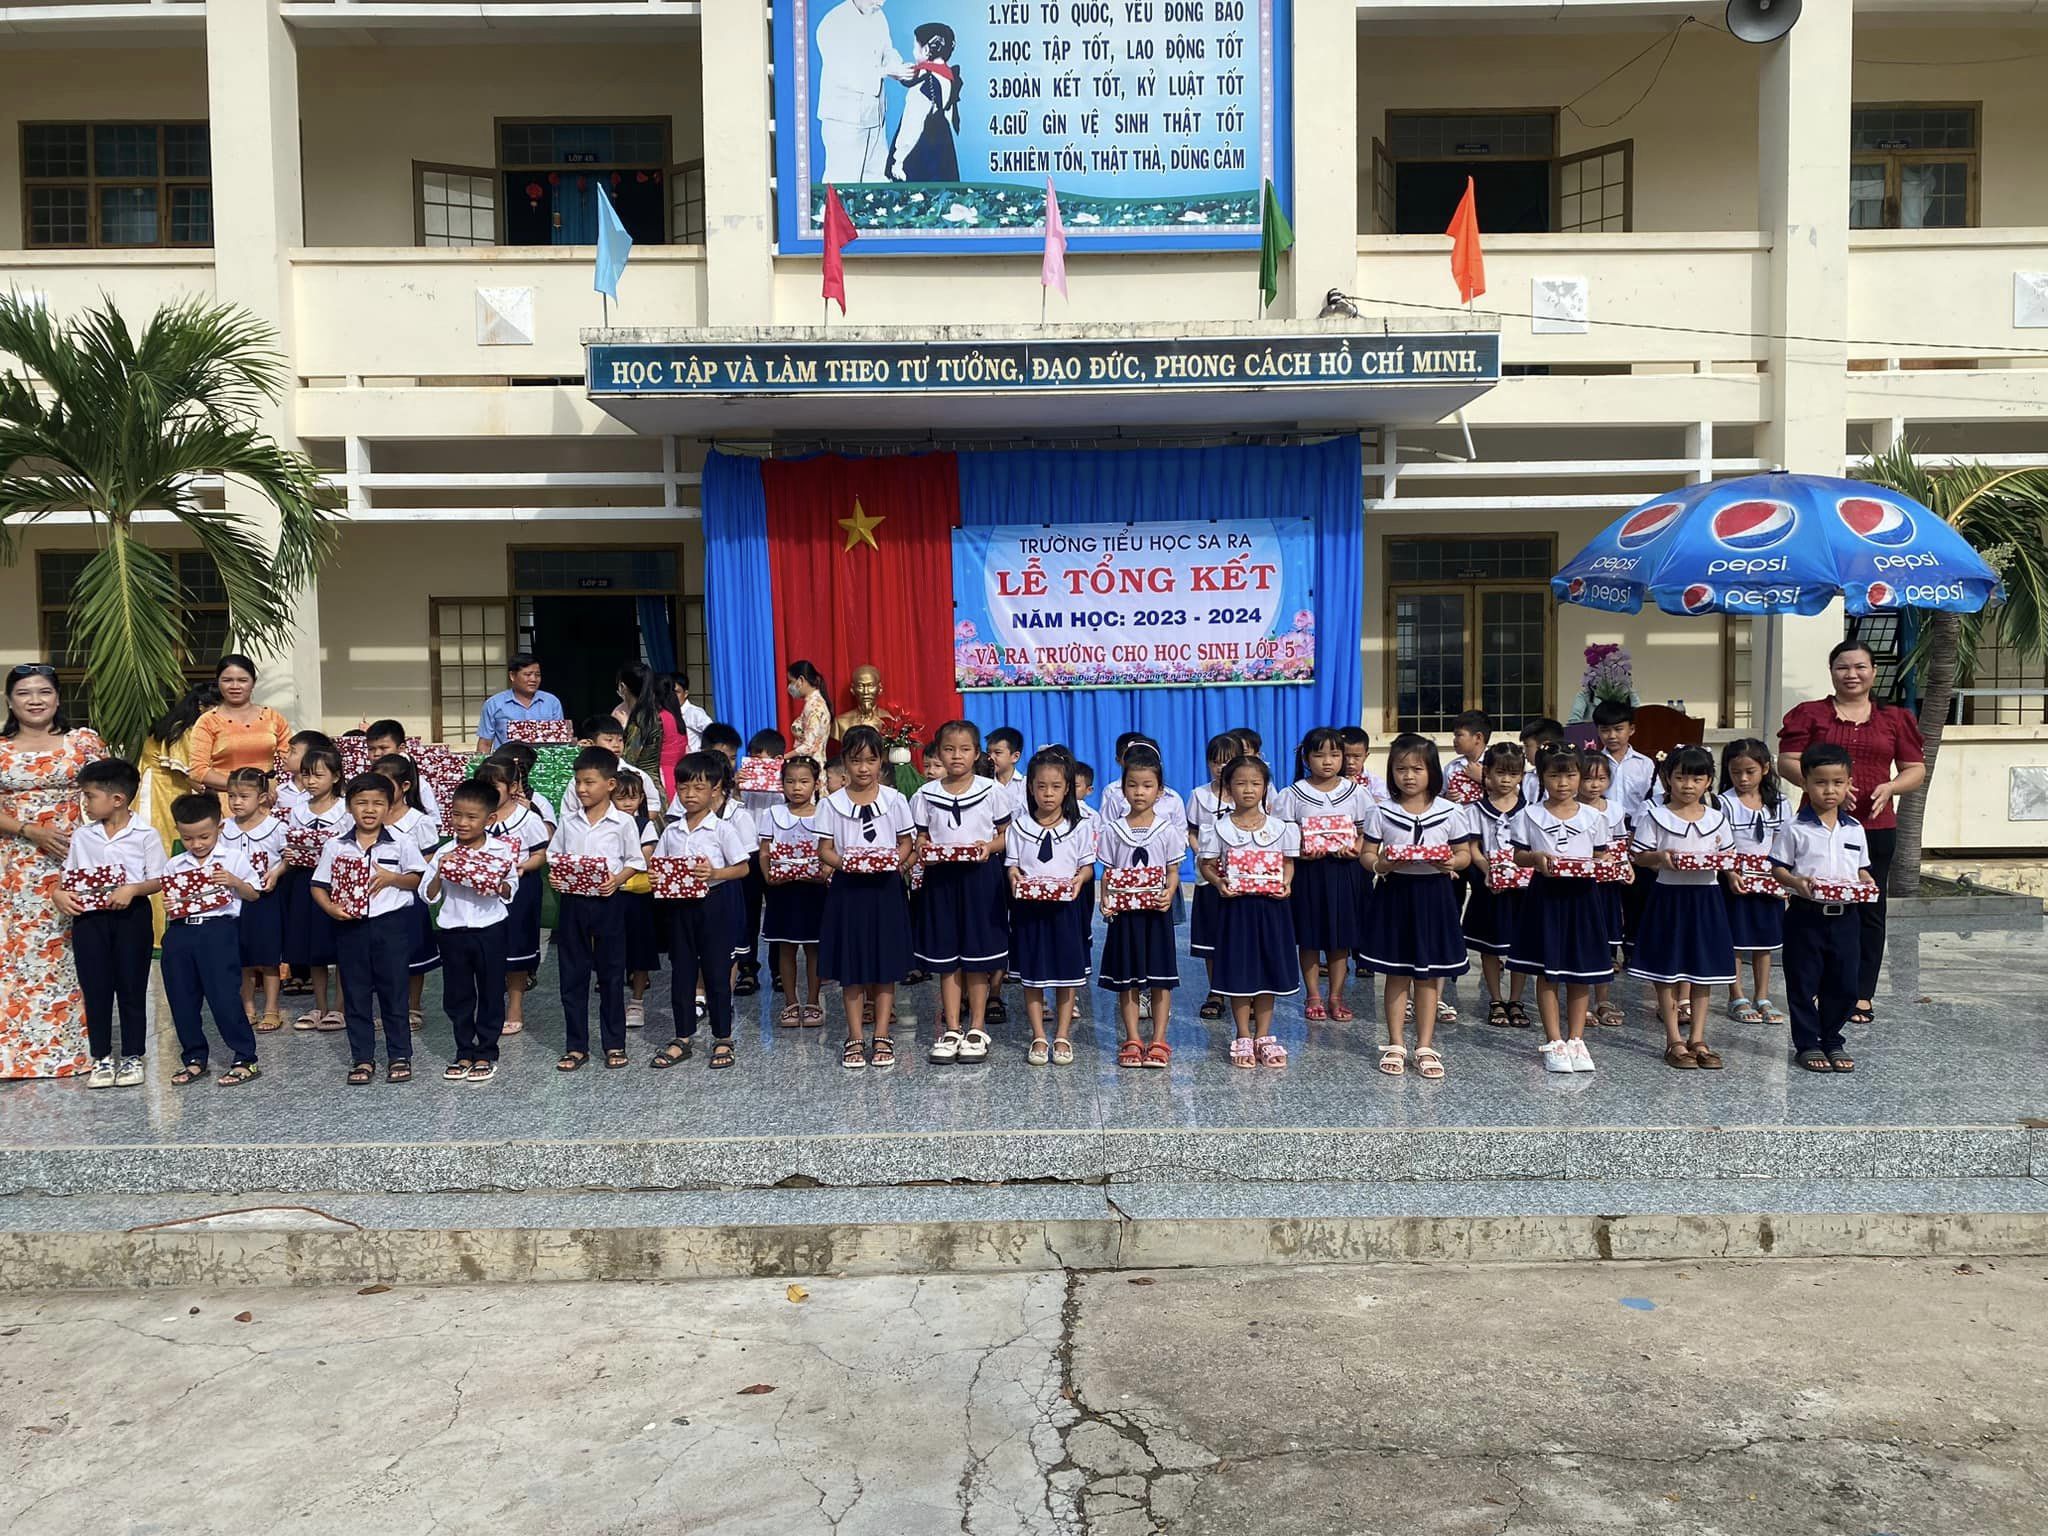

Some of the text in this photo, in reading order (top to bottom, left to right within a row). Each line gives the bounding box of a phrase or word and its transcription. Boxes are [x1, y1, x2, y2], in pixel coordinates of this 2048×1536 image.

[989, 30, 1244, 65] 2.HỌC TẬP TỐT, LAO ĐỘNG TỐT
[989, 67, 1244, 101] 3.ĐOÀN KẾT TỐT, KỶ LUẬT TỐT
[989, 104, 1244, 137] 4.GIỮ GÌN VỆ SINH THẬT TỐT
[990, 141, 1245, 175] 5.KHIÊM TỐN, THẬT THÀ, DŨNG CẢM
[611, 340, 1483, 389] HỌC TẬP VÀ LÀM THEO TƯ TƯỞNG, ĐẠO ĐỨC, PHONG CÁCH HỒ CHÍ MINH.
[1019, 528, 1252, 555] TRƯỜNG TIỂU HỌC SA RA
[996, 553, 1276, 596] LỄ TỔNG KẾT
[1590, 555, 1641, 571] pepsi
[1707, 555, 1786, 575] pepsi
[1872, 551, 1938, 571] pepsi
[1591, 585, 1632, 603] pepsi
[1725, 587, 1801, 608] pepsi
[1904, 581, 1965, 604] pepsi
[1012, 609, 1063, 629] NĂM
[1071, 610, 1125, 632] HỌC:
[1134, 609, 1187, 626] 2023
[1208, 607, 1261, 624] 2024
[975, 638, 1295, 665] VÀ RA TRƯỜNG CHO HỌC SINH LỚP 5
